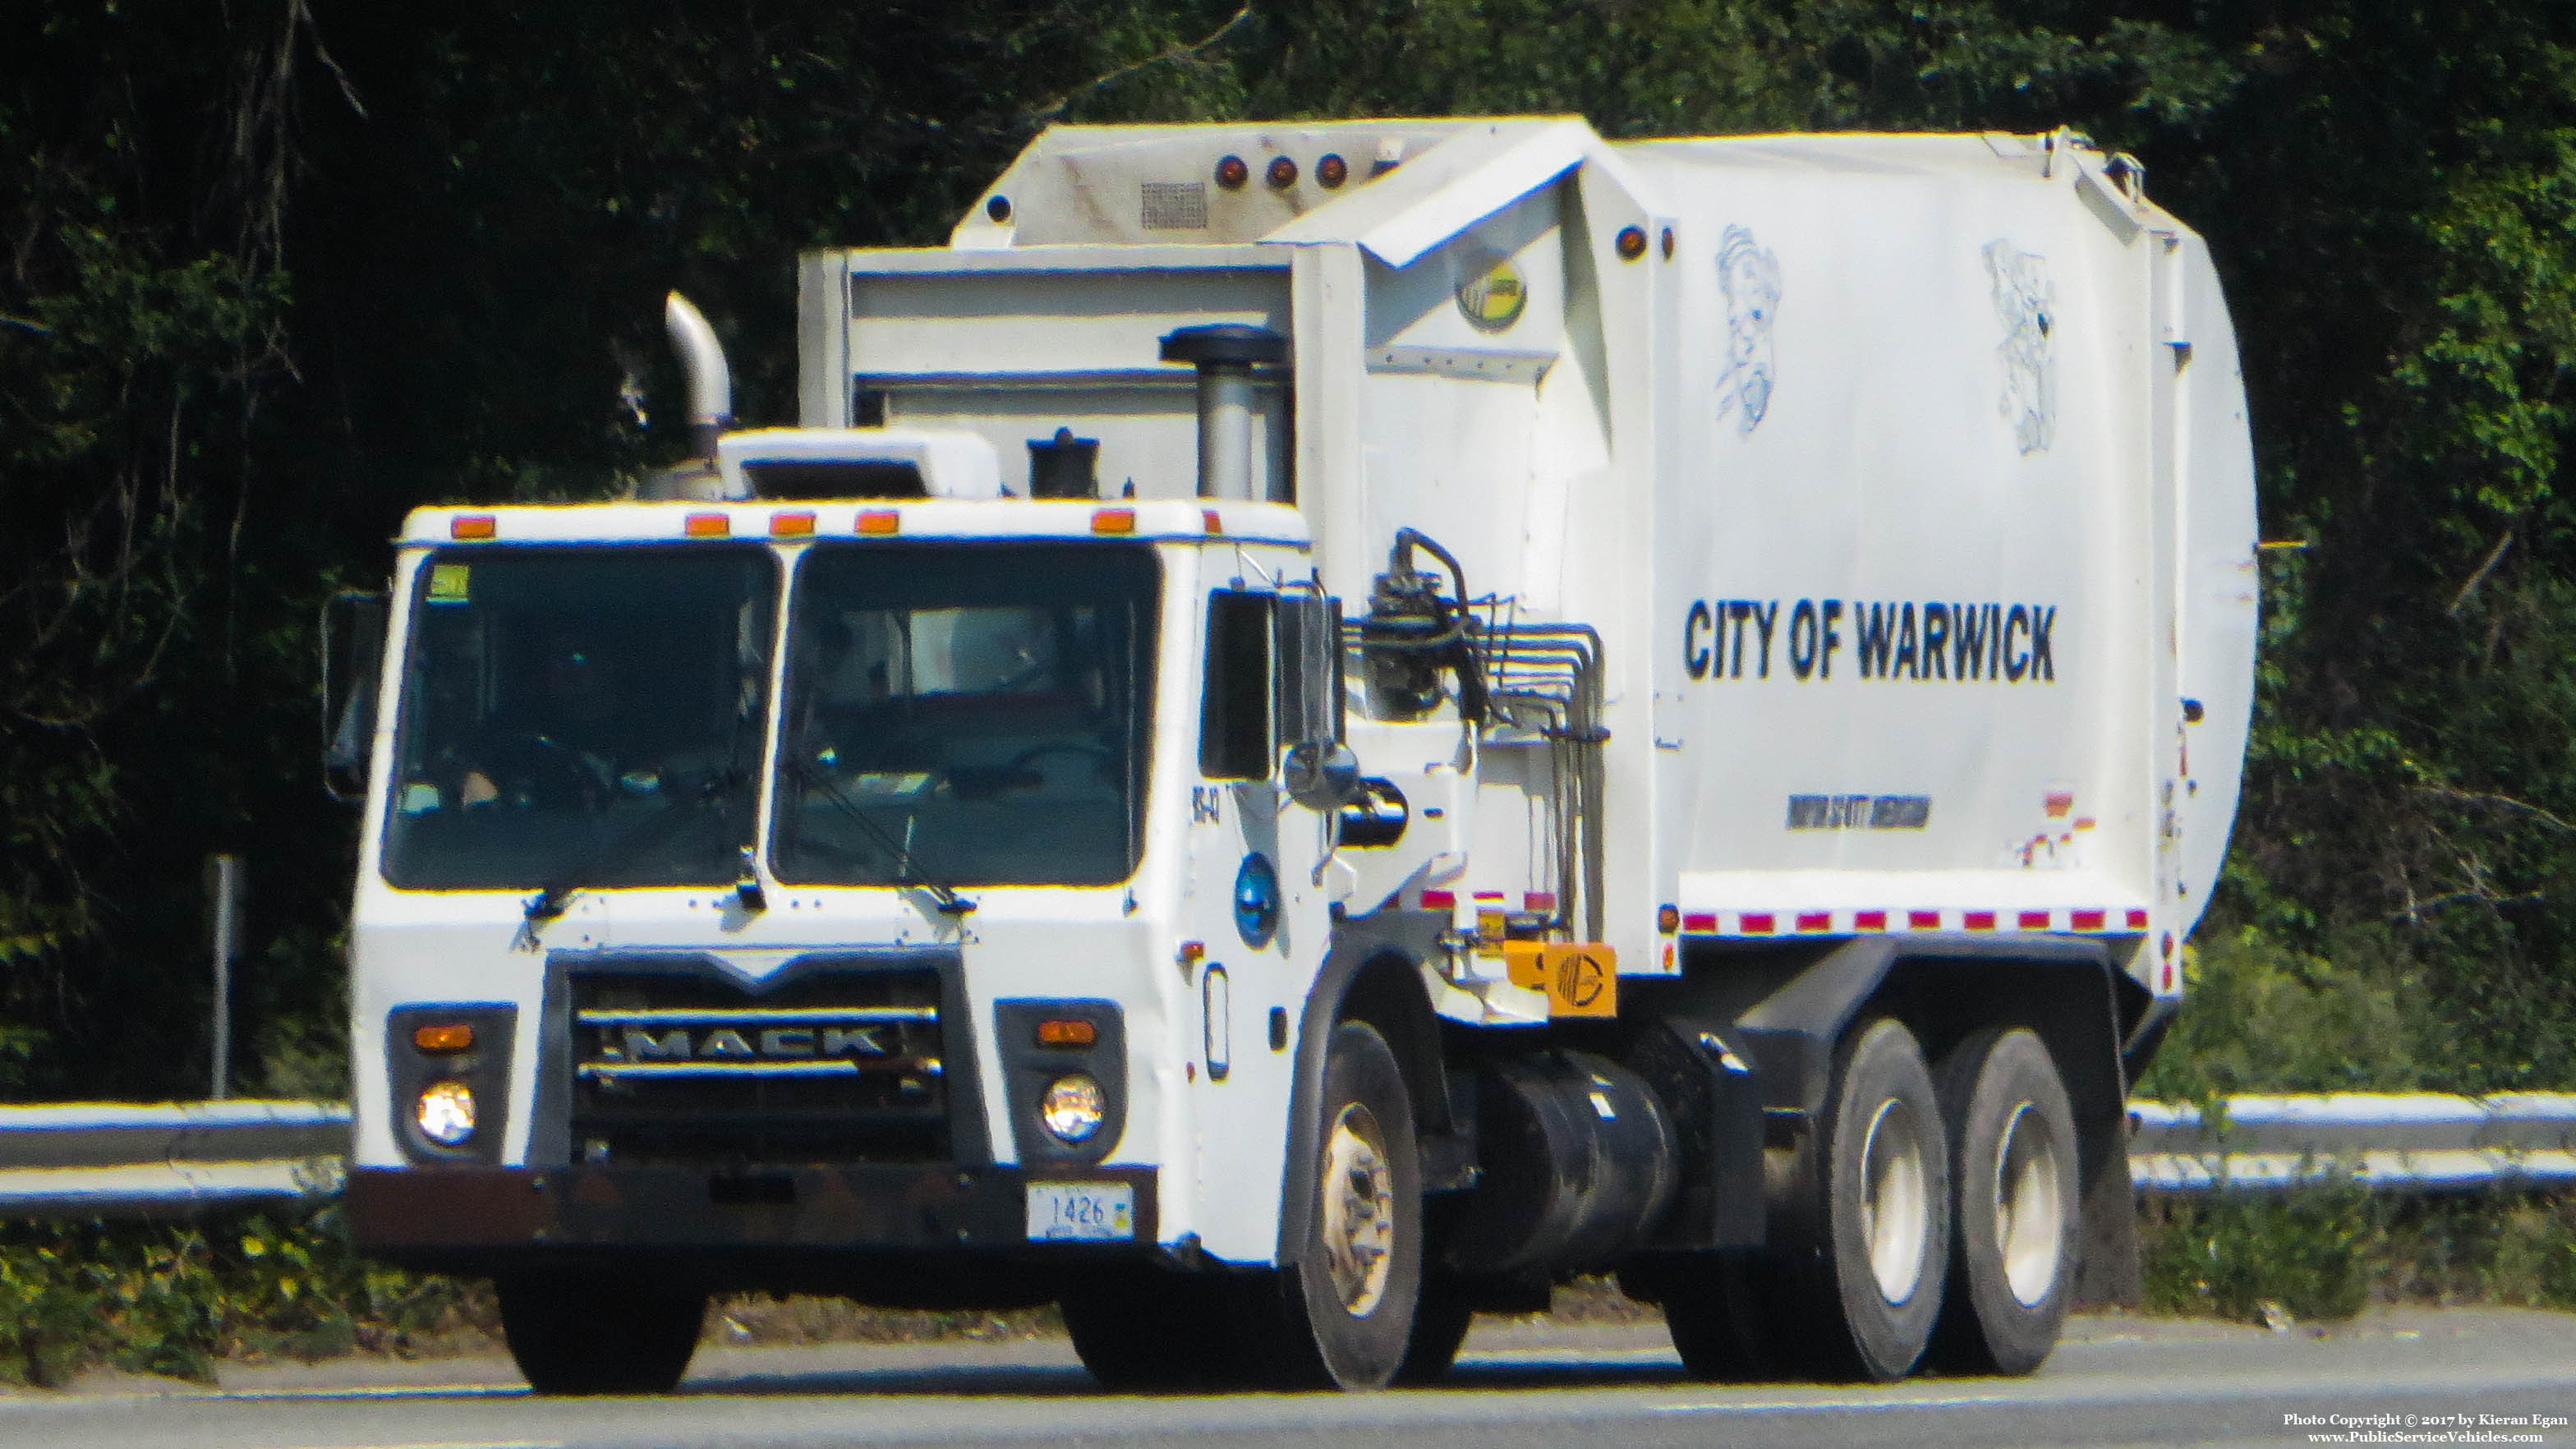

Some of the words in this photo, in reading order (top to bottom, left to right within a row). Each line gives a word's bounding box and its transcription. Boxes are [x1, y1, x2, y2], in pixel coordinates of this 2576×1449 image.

[1685, 599, 1778, 681] CITY
[1789, 598, 1842, 681] OF
[1855, 600, 2057, 682] WARWICK
[623, 1028, 886, 1058] MACK
[1052, 1195, 1105, 1225] 1426
